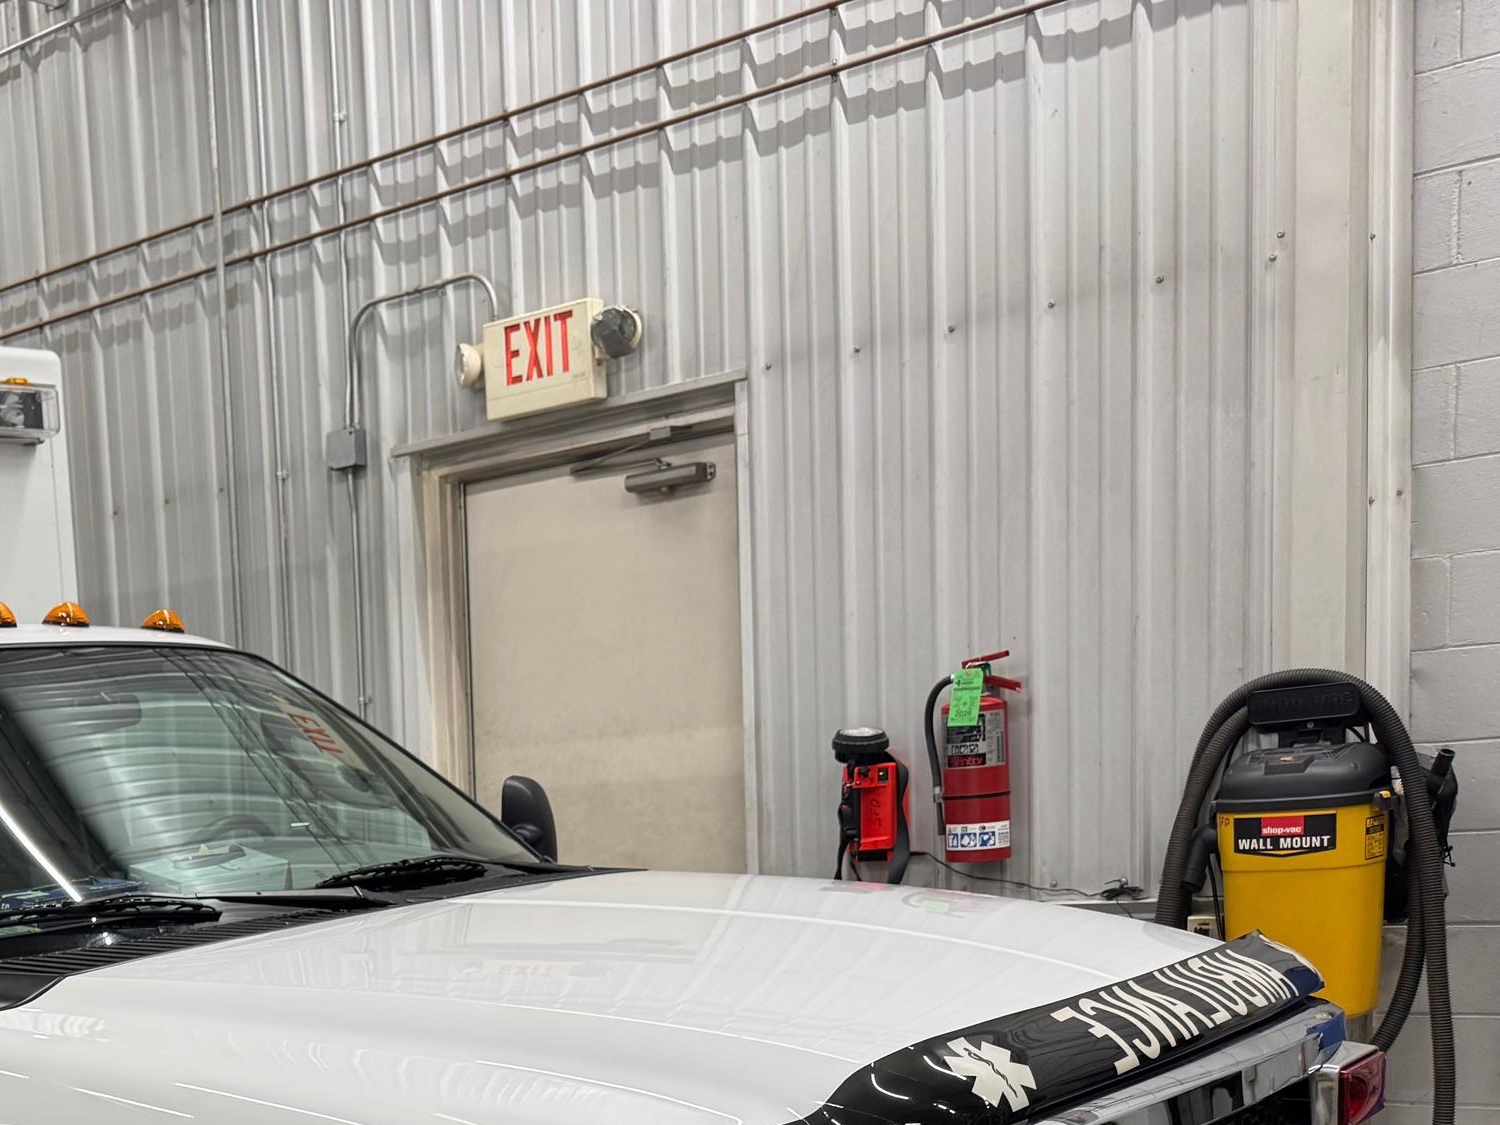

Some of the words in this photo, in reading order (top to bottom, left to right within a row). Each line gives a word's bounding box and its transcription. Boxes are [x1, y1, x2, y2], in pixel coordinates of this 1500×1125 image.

[504, 310, 573, 386] EXIT
[1262, 825, 1302, 836] shop-vac
[1238, 839, 1273, 851] WALL
[1279, 835, 1332, 849] MOUNT
